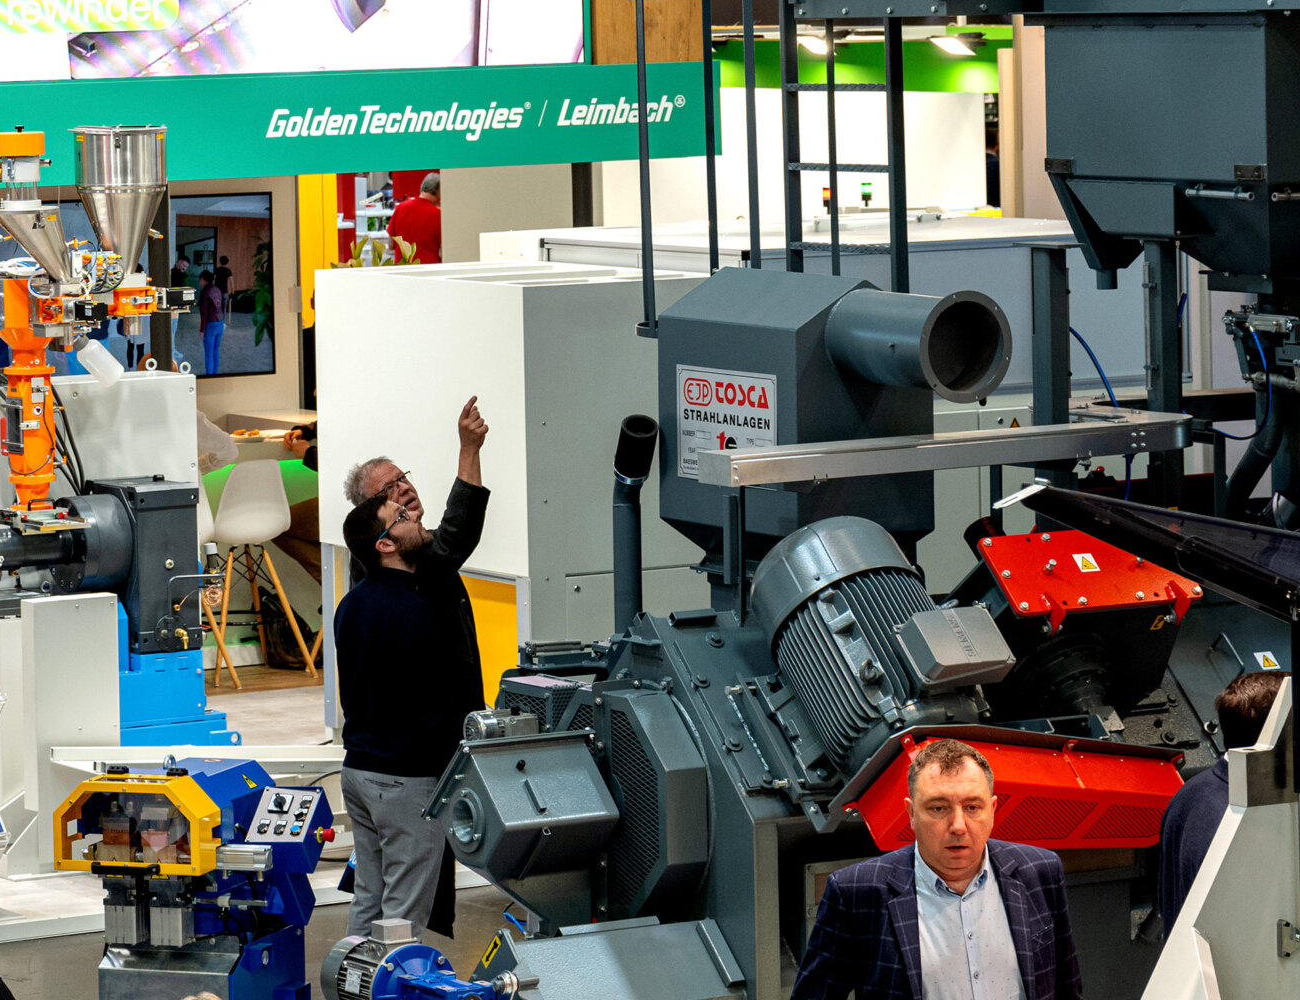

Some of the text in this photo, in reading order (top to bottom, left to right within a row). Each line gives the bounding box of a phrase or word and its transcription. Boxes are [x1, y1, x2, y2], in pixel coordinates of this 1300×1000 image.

[266, 107, 359, 138] Golden
[687, 381, 769, 409] EJP TOSCA
[683, 408, 770, 430] STRAHLANLAGEN
